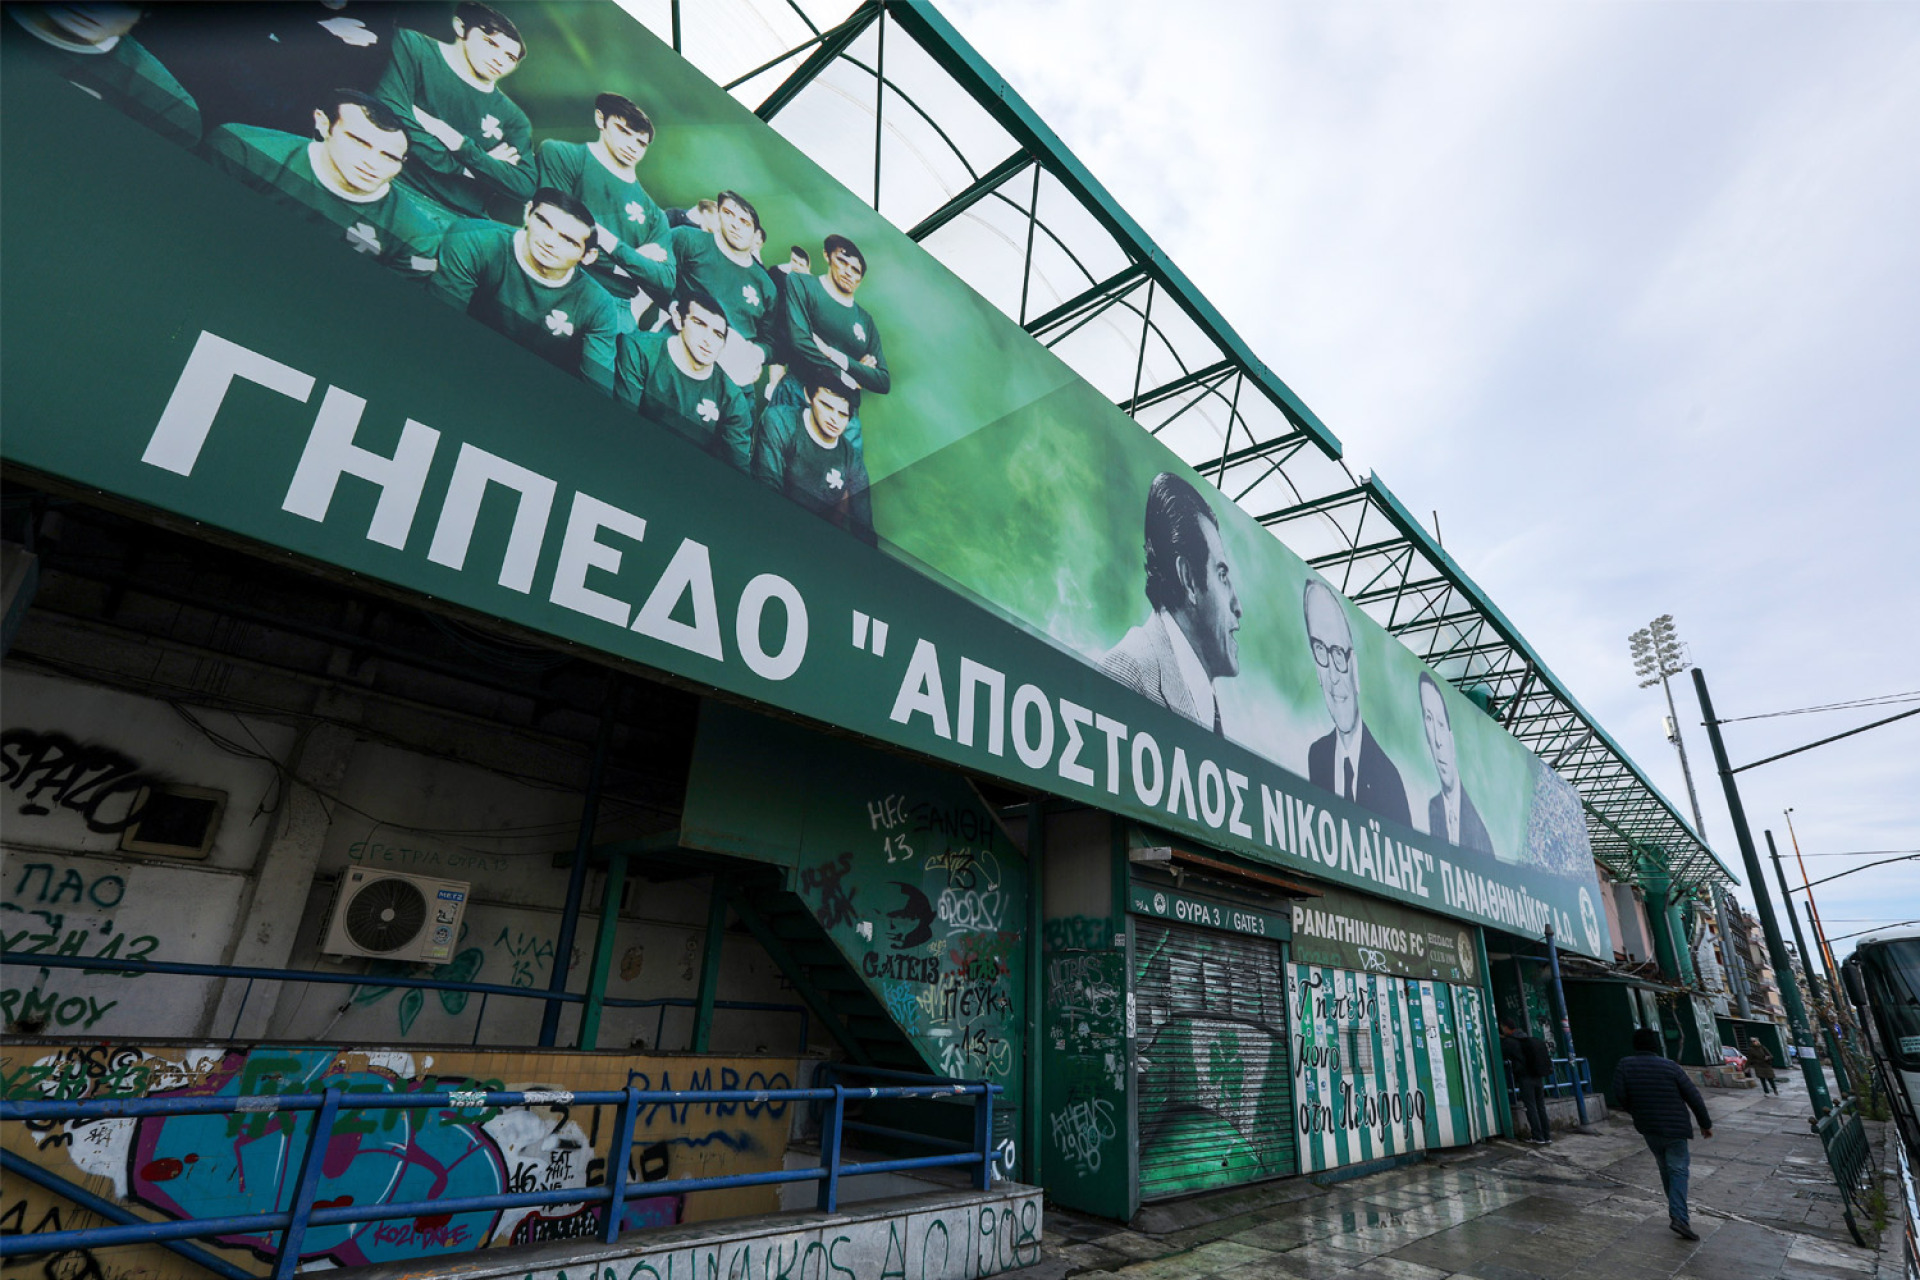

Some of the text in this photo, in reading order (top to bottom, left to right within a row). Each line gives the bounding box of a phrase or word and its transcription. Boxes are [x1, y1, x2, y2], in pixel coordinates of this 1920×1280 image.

[141, 330, 808, 681] ΓΗΠΕΔΟ
[852, 609, 1252, 840] "ΑΠΟΣΤΟΛΟΣ
[884, 832, 913, 863] 13
[910, 803, 993, 849] ΞΑΝΘΗ
[16, 864, 124, 907] ΠΑΟ
[1175, 899, 1211, 924] ΘΥΡΑ
[1212, 908, 1220, 926] 3
[1233, 912, 1258, 933] GATE
[1258, 918, 1265, 935] 3
[1292, 905, 1425, 957] PANATHINAIKOS FC
